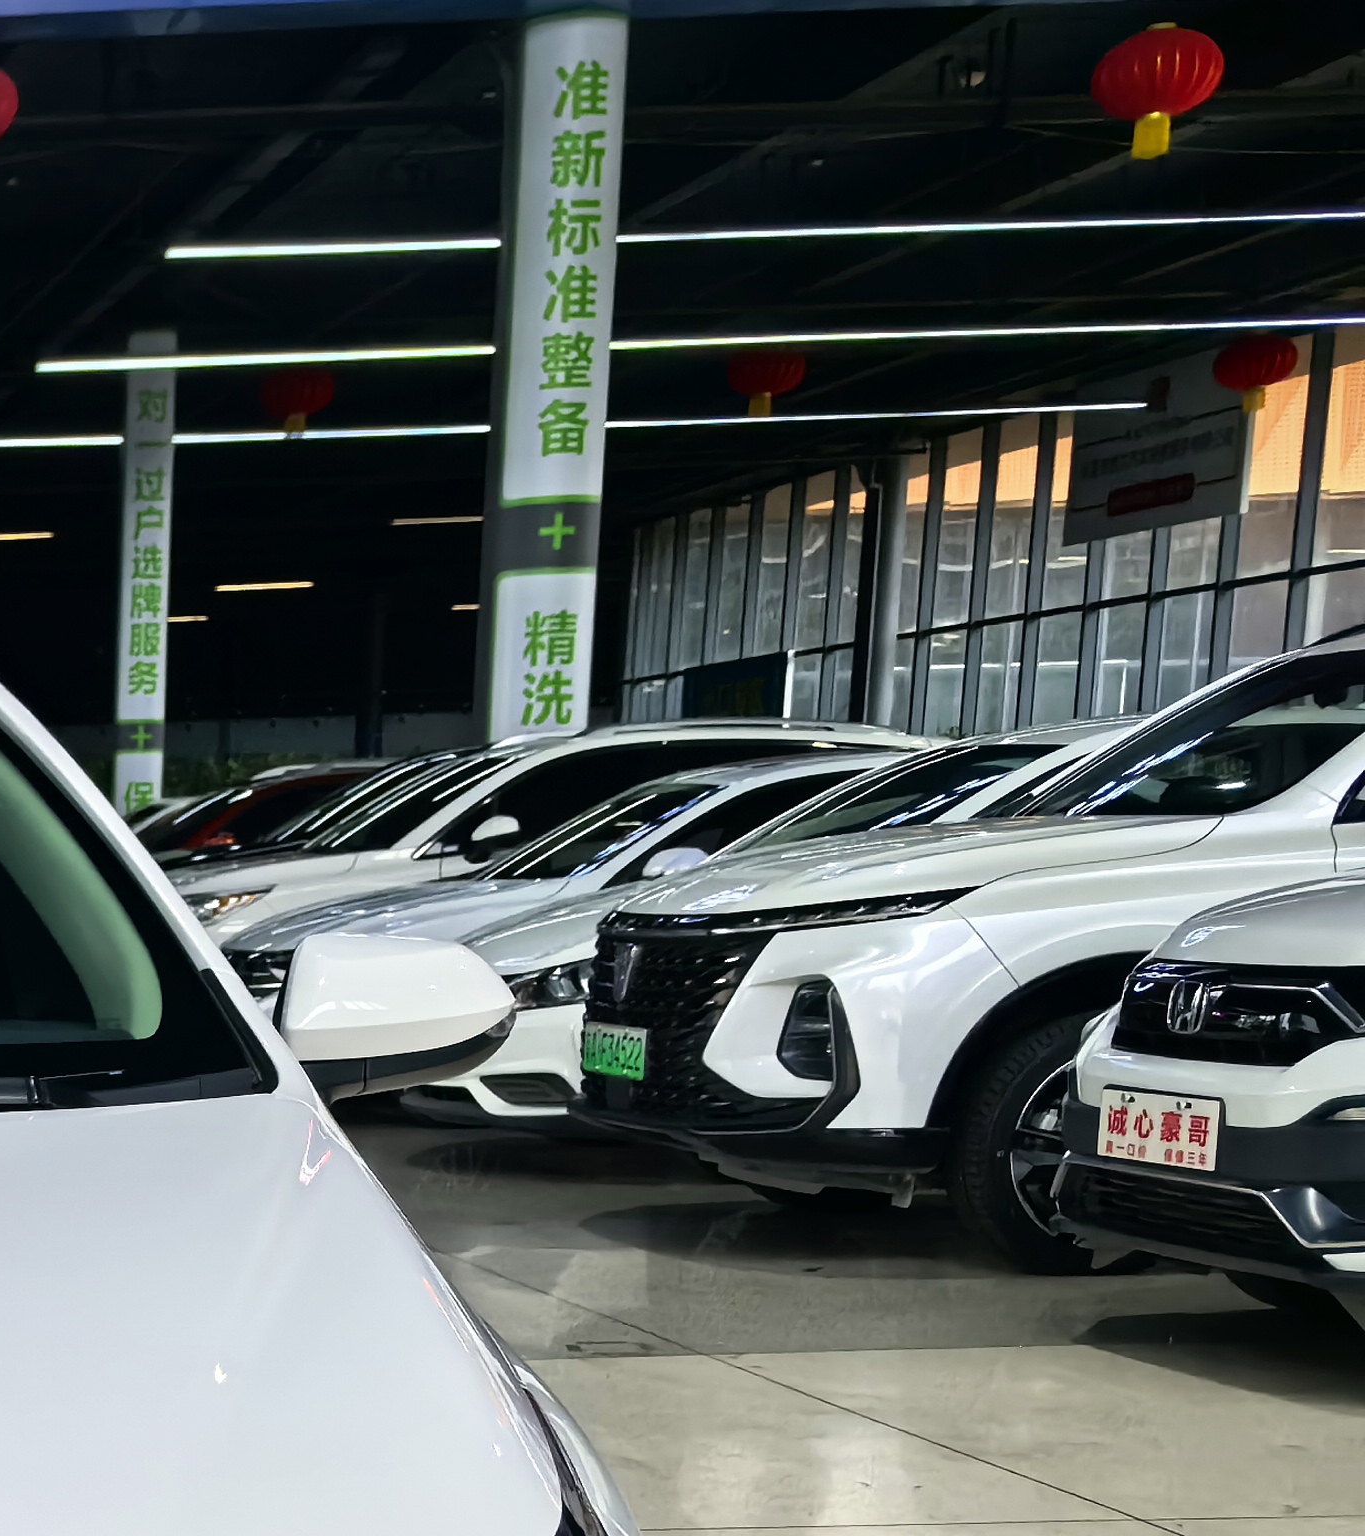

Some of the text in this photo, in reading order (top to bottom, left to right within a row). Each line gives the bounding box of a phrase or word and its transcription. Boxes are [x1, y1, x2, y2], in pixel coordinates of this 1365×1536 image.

[537, 60, 609, 457] 准新标准整备
[521, 609, 578, 726] 精洗
[1107, 1104, 1211, 1148] 诚心豪哥
